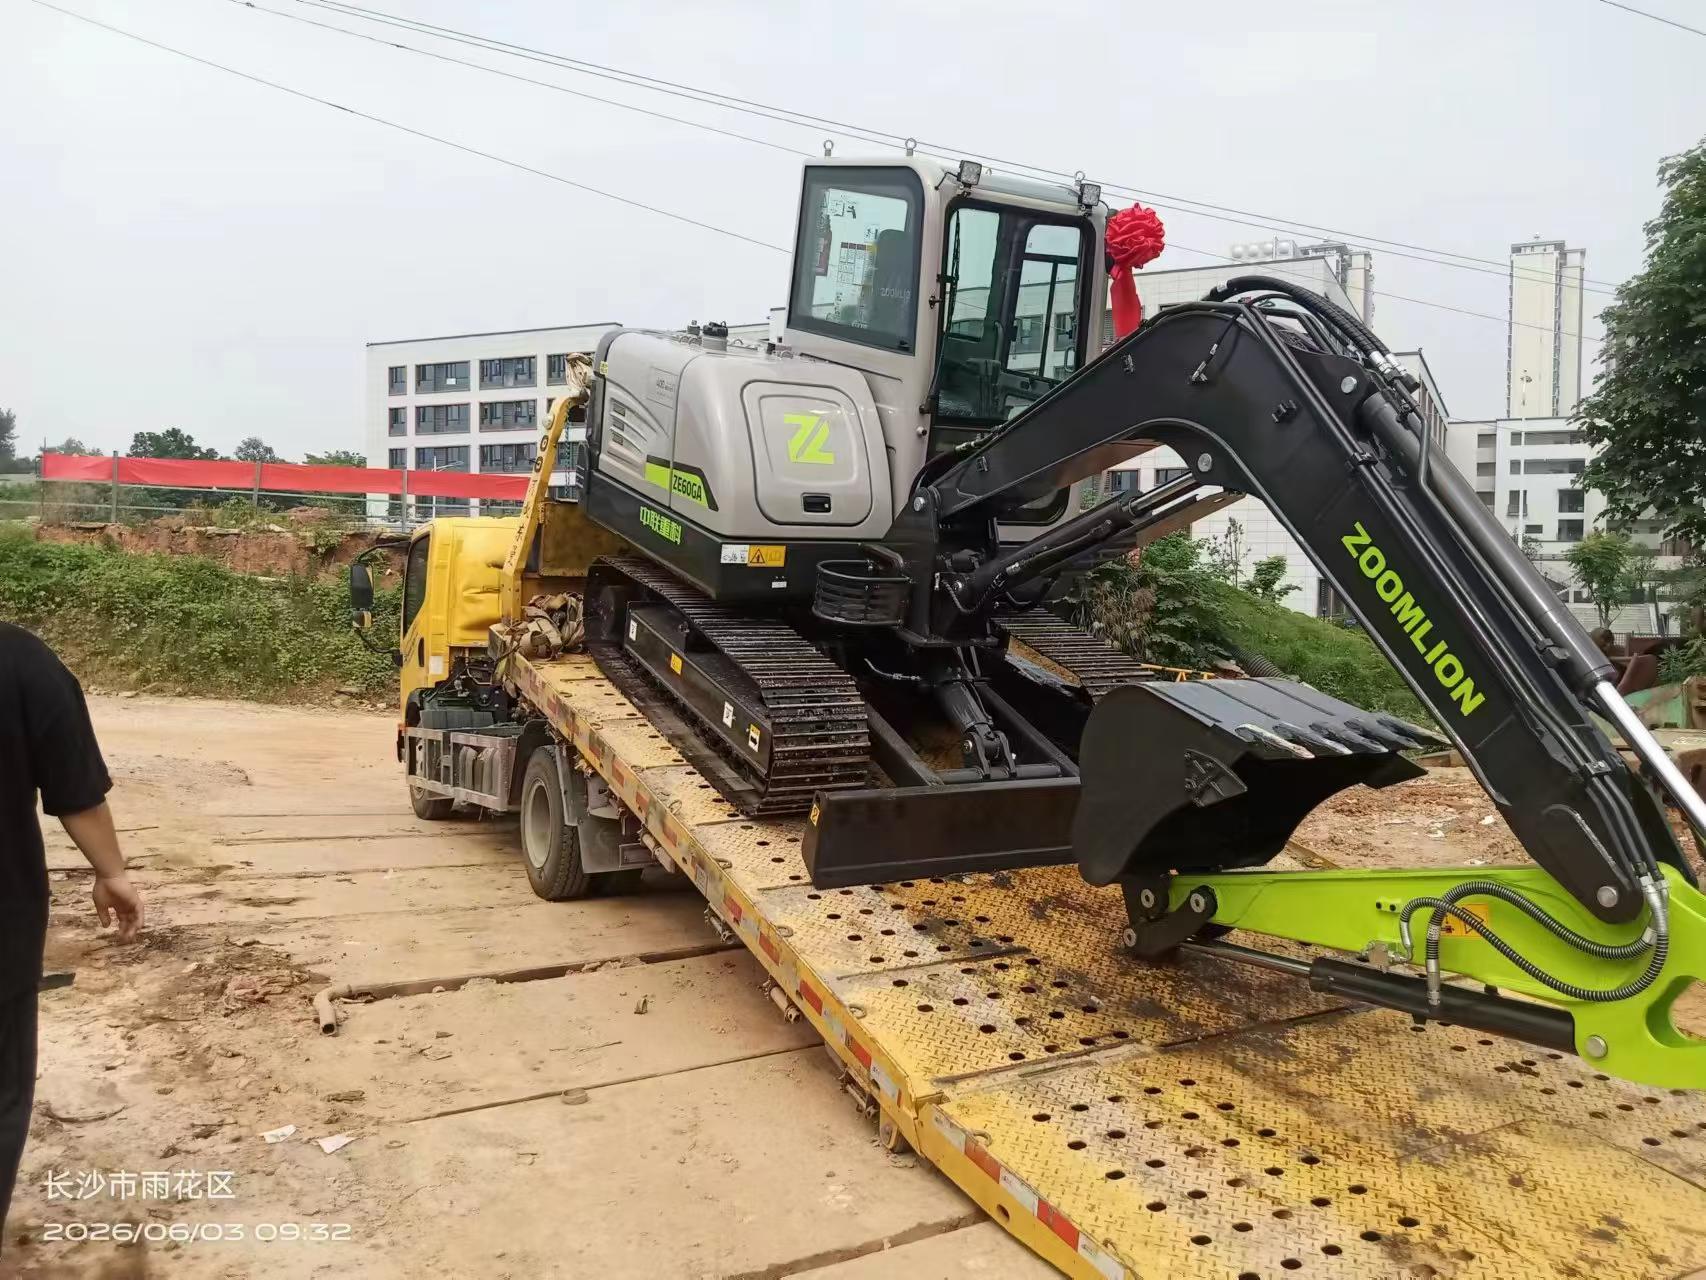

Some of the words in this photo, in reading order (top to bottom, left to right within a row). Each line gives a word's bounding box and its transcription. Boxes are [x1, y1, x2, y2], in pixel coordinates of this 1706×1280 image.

[673, 475, 702, 501] ZE60GA
[640, 506, 682, 545] 中联重科
[1341, 521, 1485, 717] ZOOMLION
